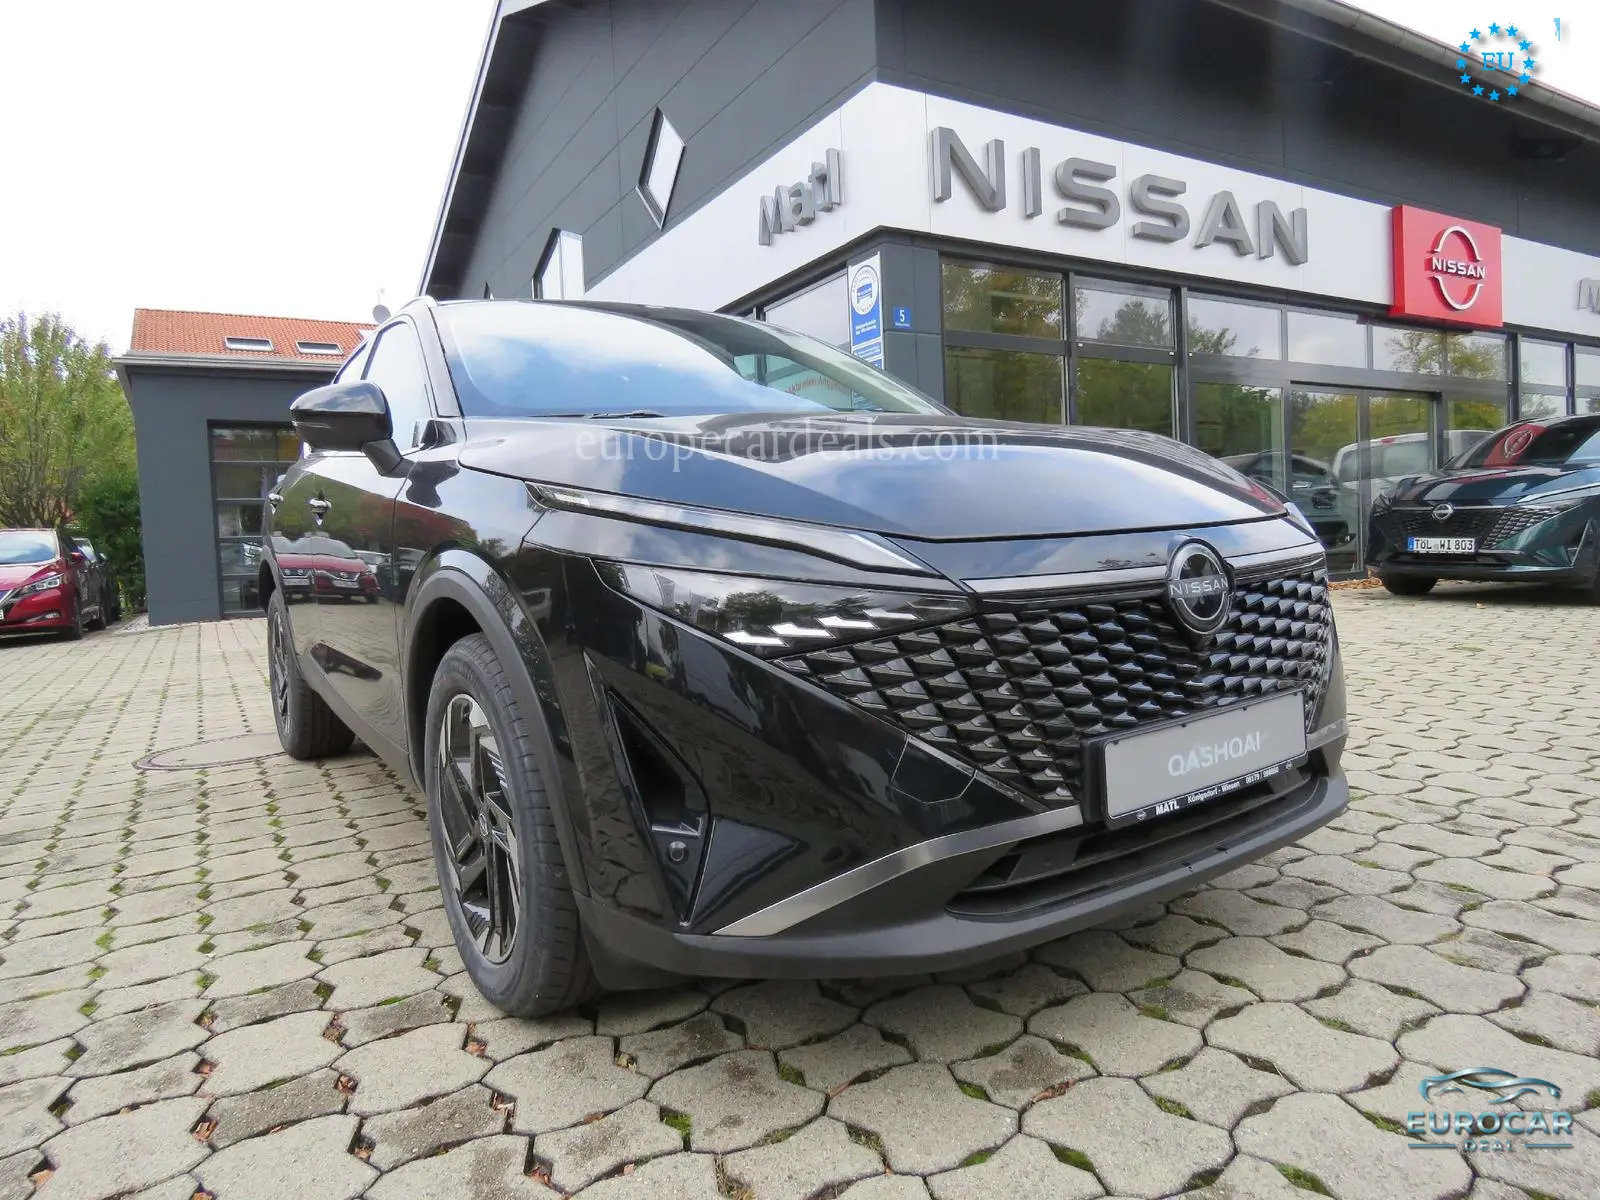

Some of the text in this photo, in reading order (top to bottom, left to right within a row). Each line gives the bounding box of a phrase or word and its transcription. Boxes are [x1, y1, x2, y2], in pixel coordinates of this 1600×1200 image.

[758, 148, 840, 246] Matl
[931, 126, 1308, 265] NISSAN
[1432, 255, 1486, 279] NISSAN
[899, 309, 906, 323] 5
[1169, 576, 1229, 596] NISSAN
[1167, 730, 1261, 777] QASHQAI
[1155, 802, 1180, 816] MATL
